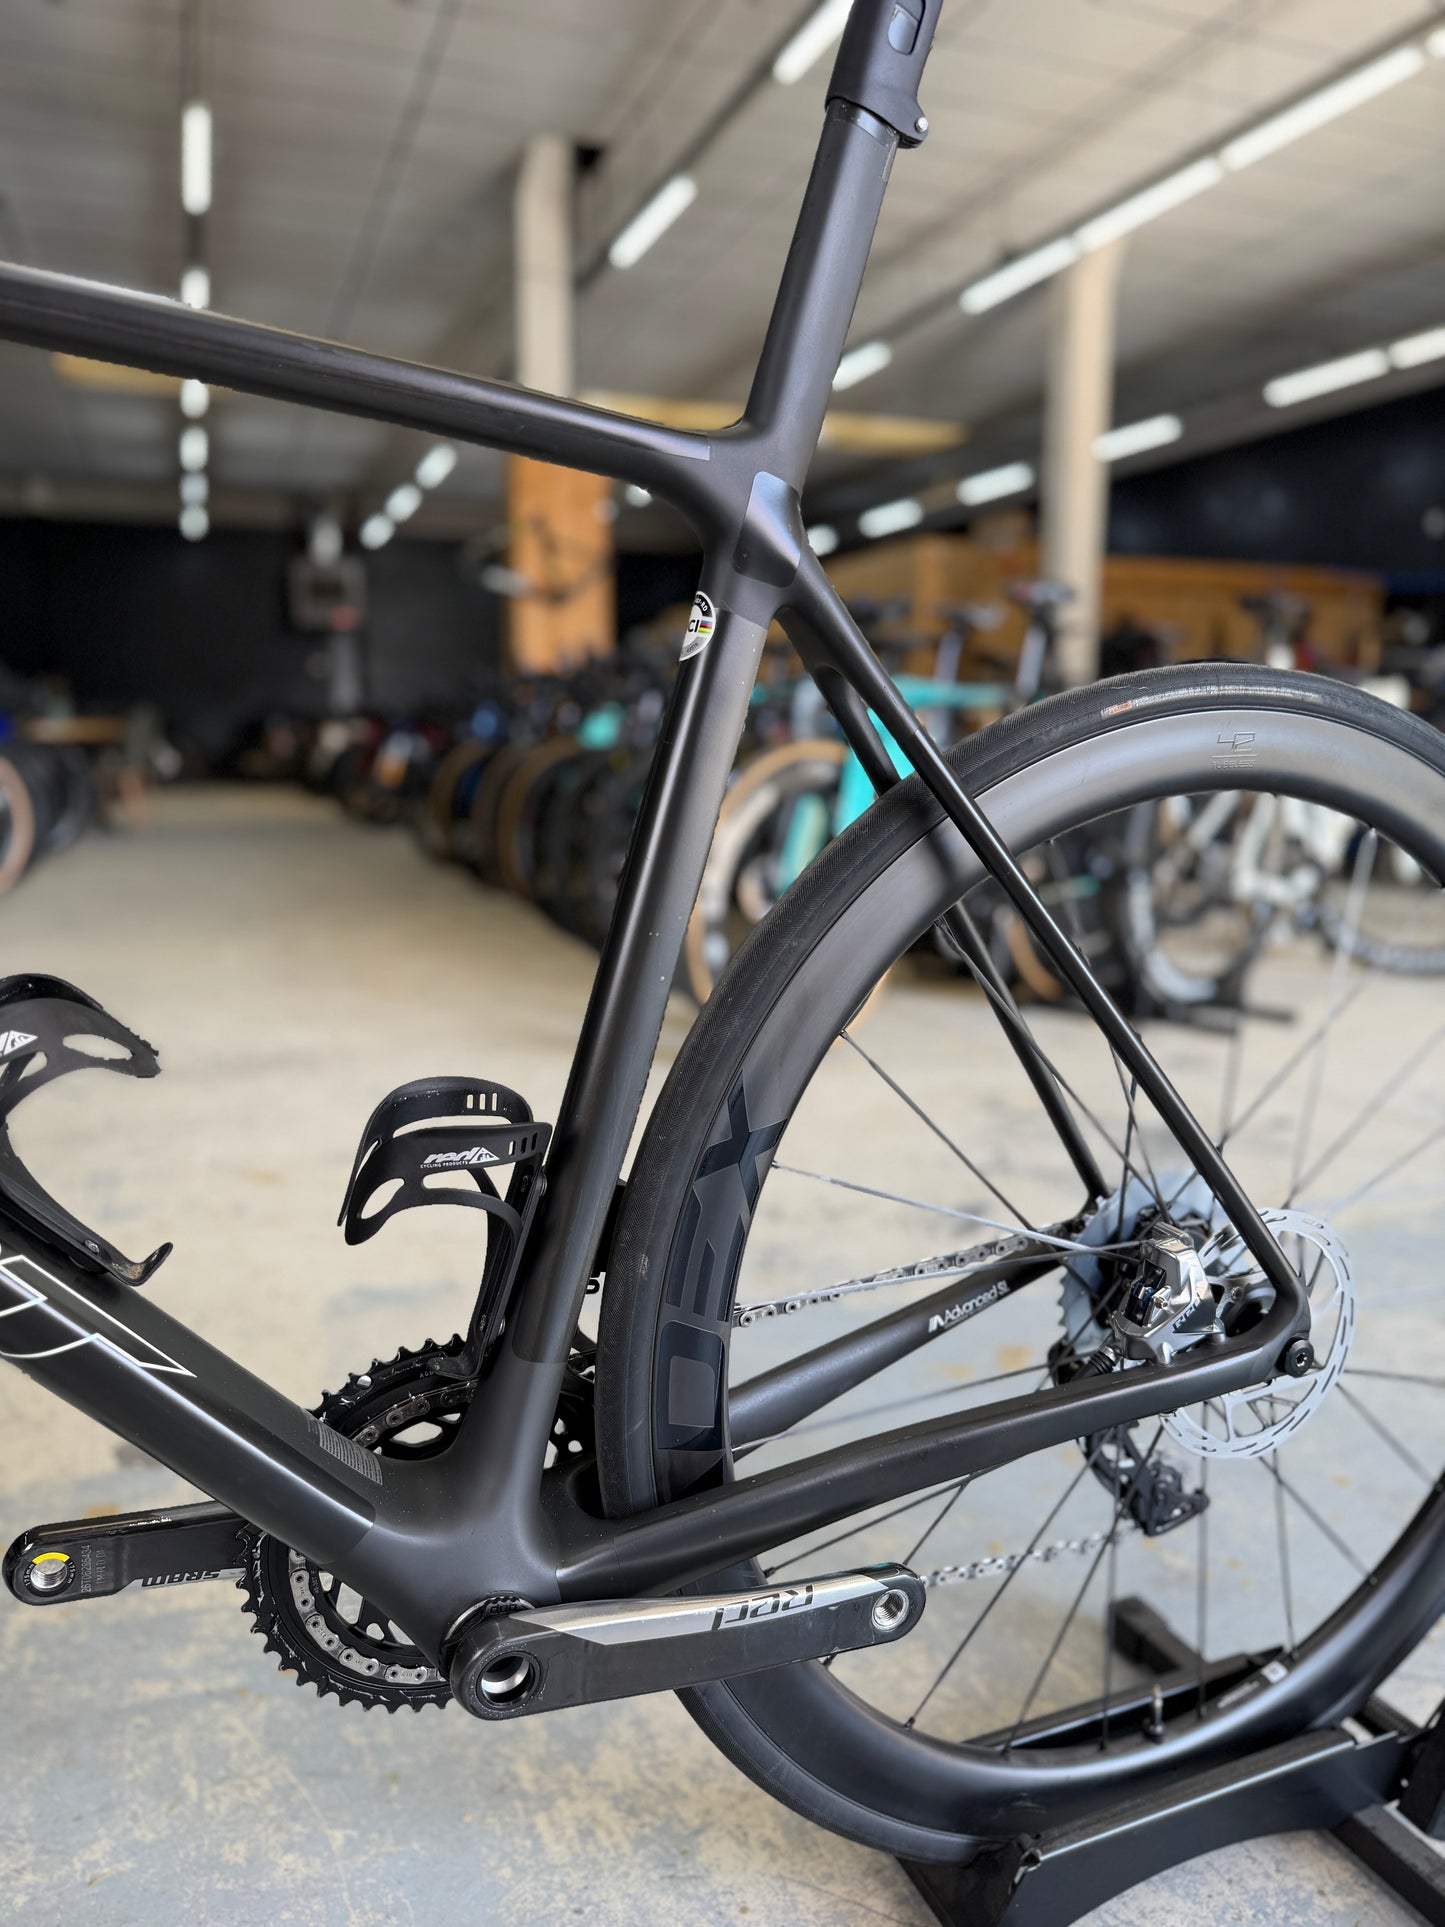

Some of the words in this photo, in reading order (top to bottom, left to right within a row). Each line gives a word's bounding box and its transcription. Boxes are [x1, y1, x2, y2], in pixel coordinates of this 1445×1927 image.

[687, 619, 700, 633] CI
[1217, 731, 1256, 752] 42
[944, 1284, 998, 1323] Advanced
[141, 1569, 221, 1588] SRAM
